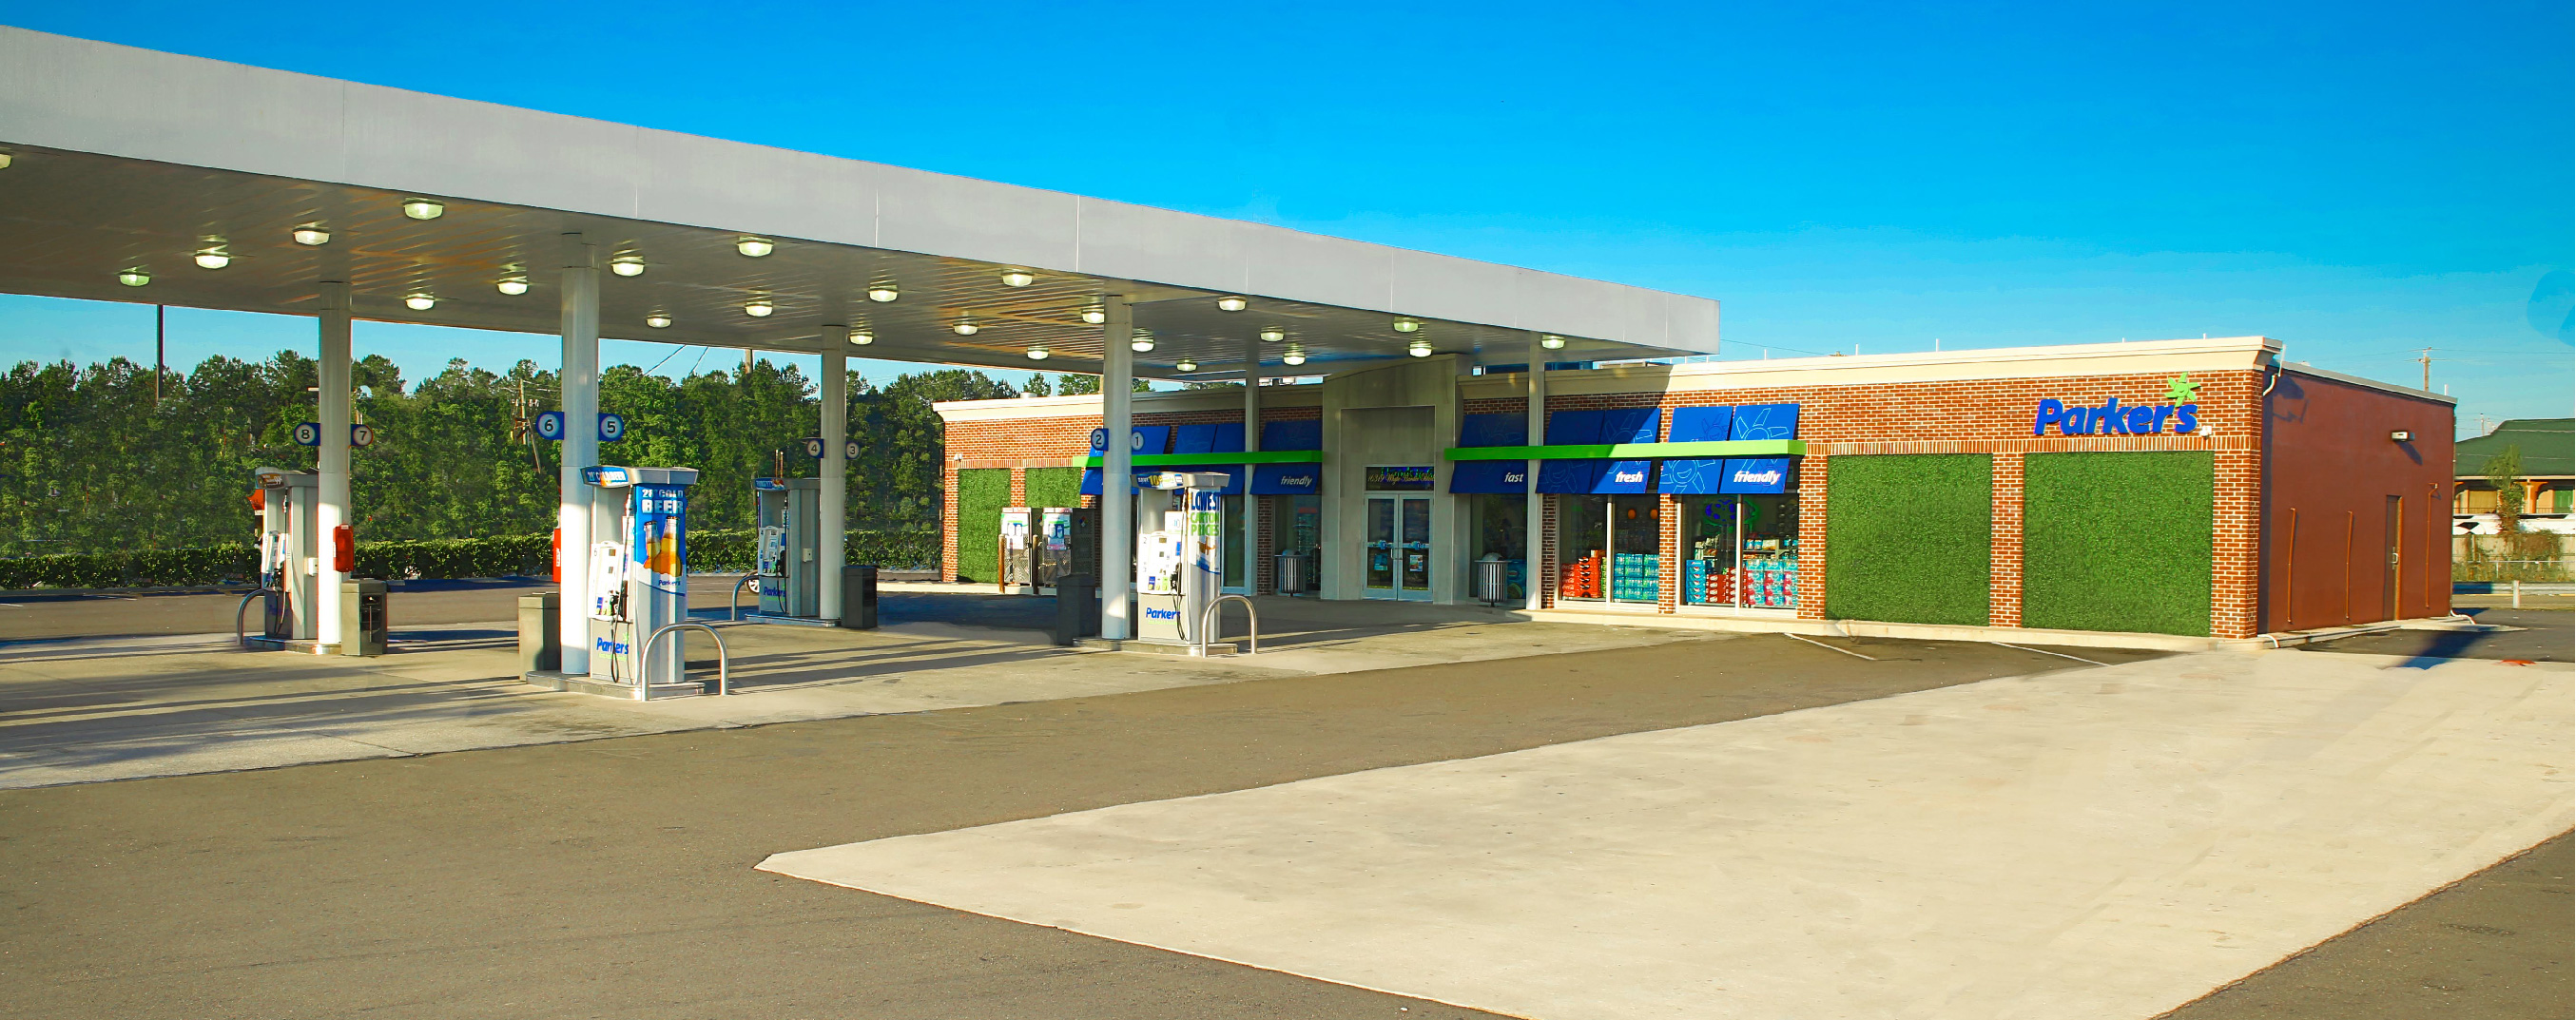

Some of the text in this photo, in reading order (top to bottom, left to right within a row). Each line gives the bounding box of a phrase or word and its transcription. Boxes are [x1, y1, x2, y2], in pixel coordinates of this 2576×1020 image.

[544, 418, 554, 432] 6
[607, 421, 616, 433] 5
[300, 429, 310, 439] 8
[359, 431, 367, 440] 7
[1095, 434, 1102, 445] 2
[1134, 436, 1139, 446] 1
[811, 444, 818, 452] 4
[849, 446, 856, 454] 3
[1280, 476, 1313, 488] friendly
[1504, 472, 1523, 482] fast
[1615, 472, 1643, 483] fresh
[1733, 471, 1781, 485] friendly
[659, 490, 683, 498] COLD
[642, 499, 684, 514] BEER
[1191, 512, 1220, 524] CARTON
[1191, 525, 1220, 536] PRICES
